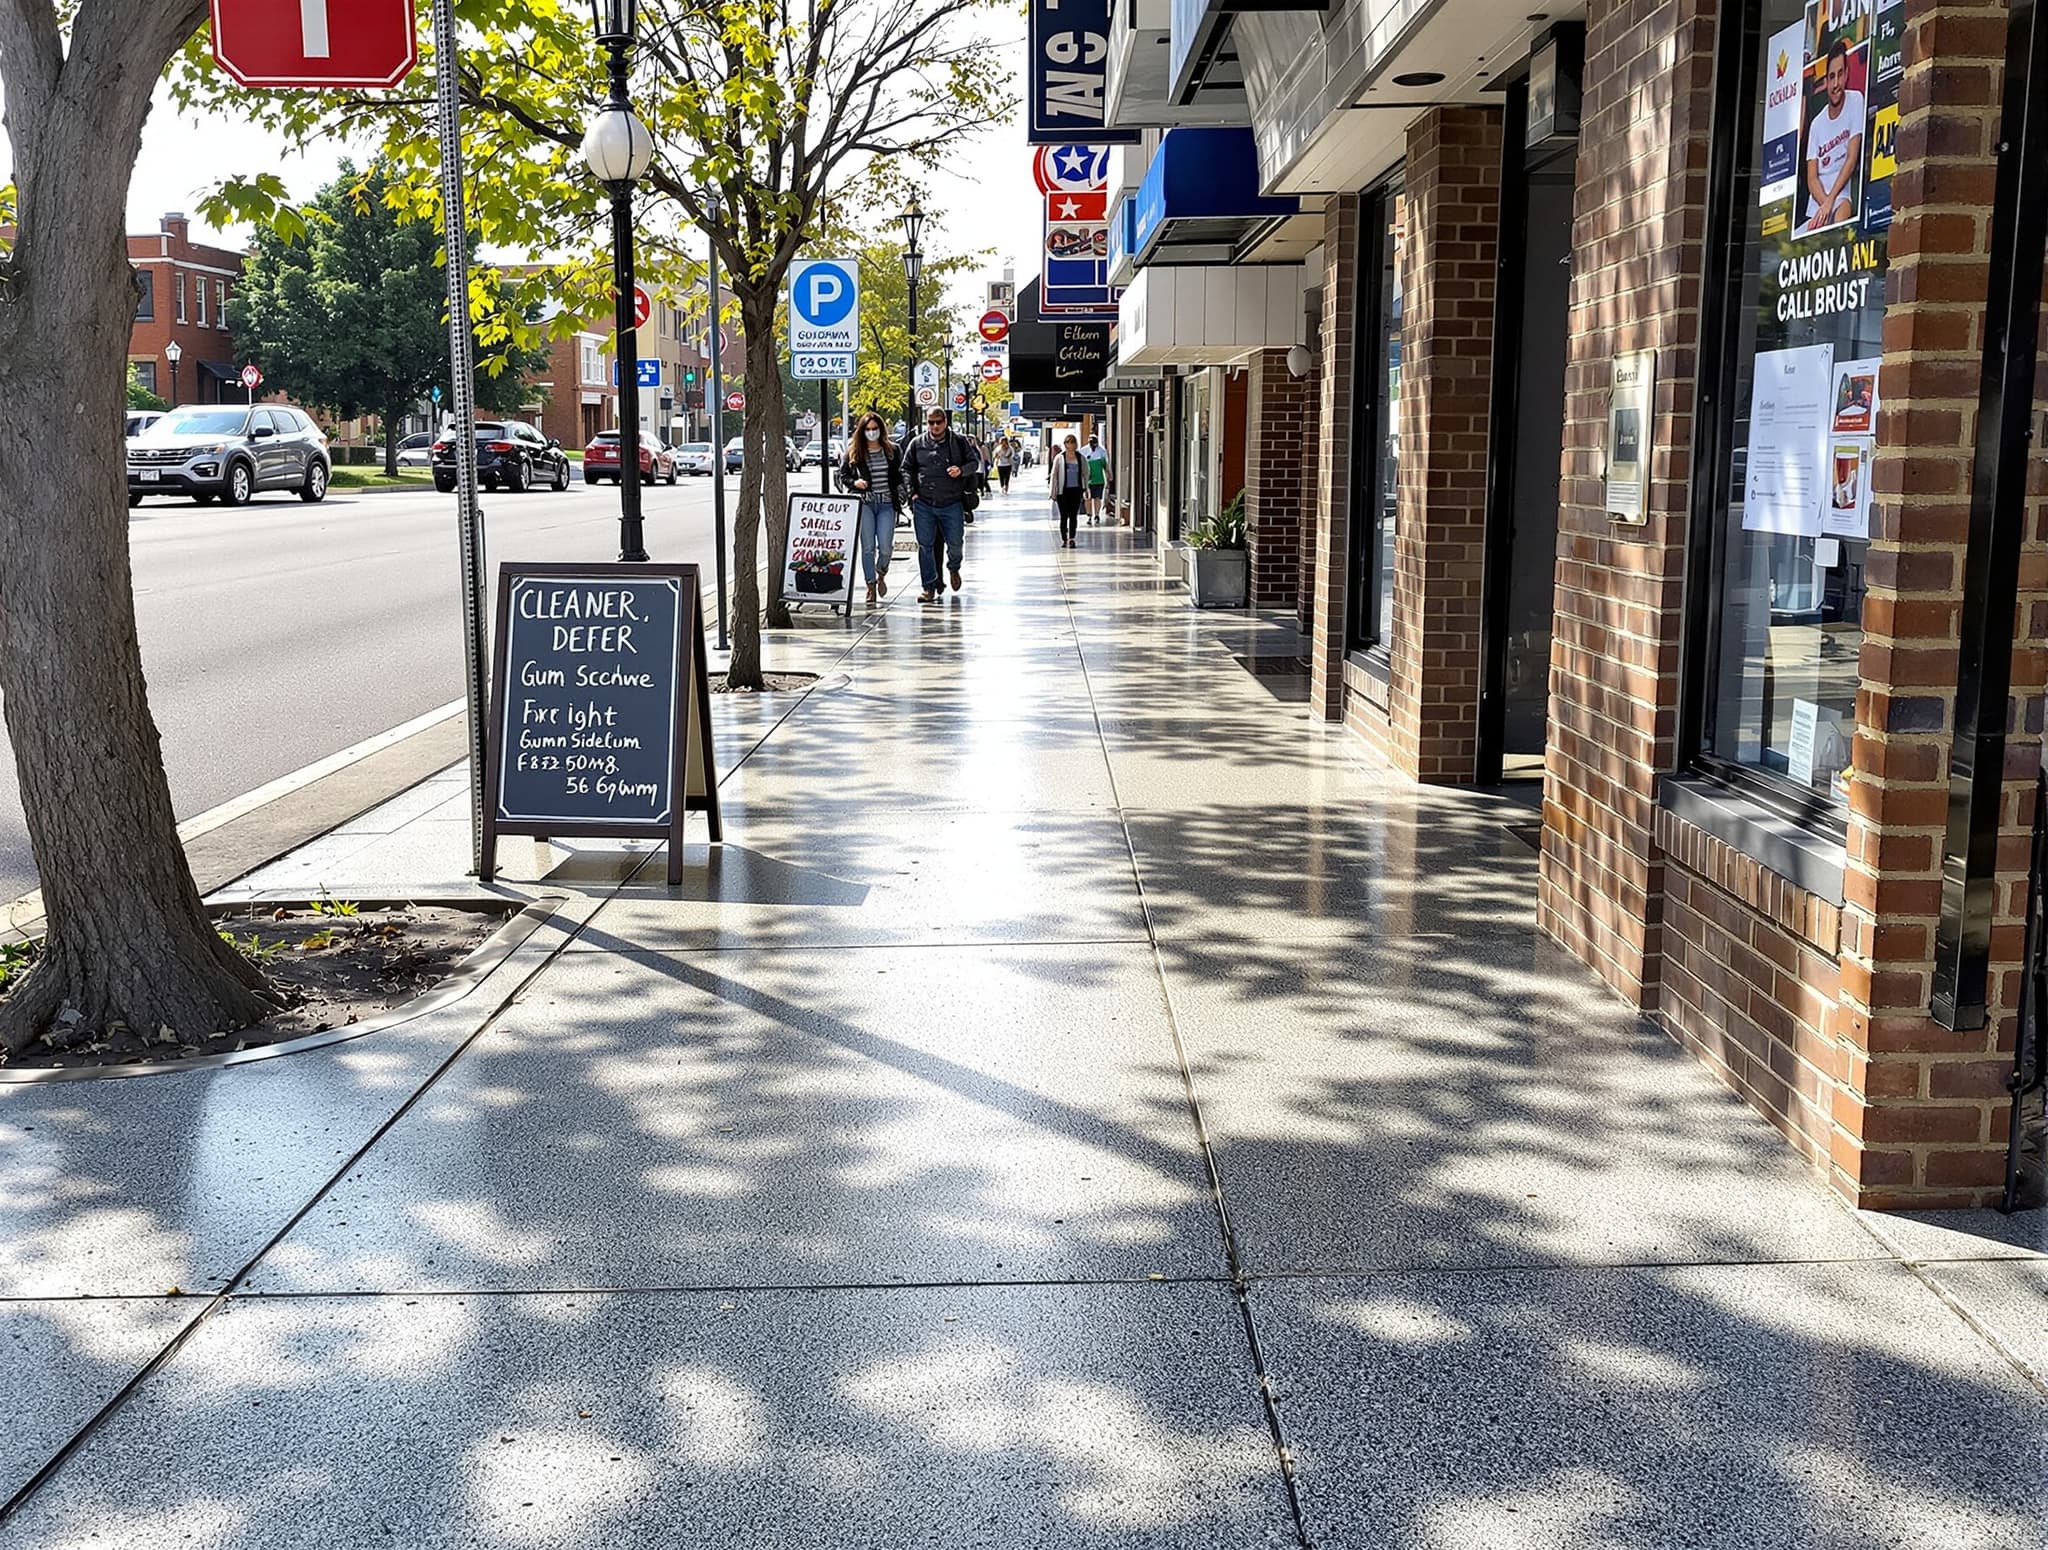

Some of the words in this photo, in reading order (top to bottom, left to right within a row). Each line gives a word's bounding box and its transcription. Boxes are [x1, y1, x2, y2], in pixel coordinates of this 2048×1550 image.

[1778, 248, 1834, 289] CAMON
[1835, 245, 1849, 276] A
[809, 274, 843, 317] P
[1777, 289, 1813, 322] CALL
[1814, 277, 1870, 316] BRUST
[552, 625, 638, 654] DEFER
[521, 660, 565, 687] Gum
